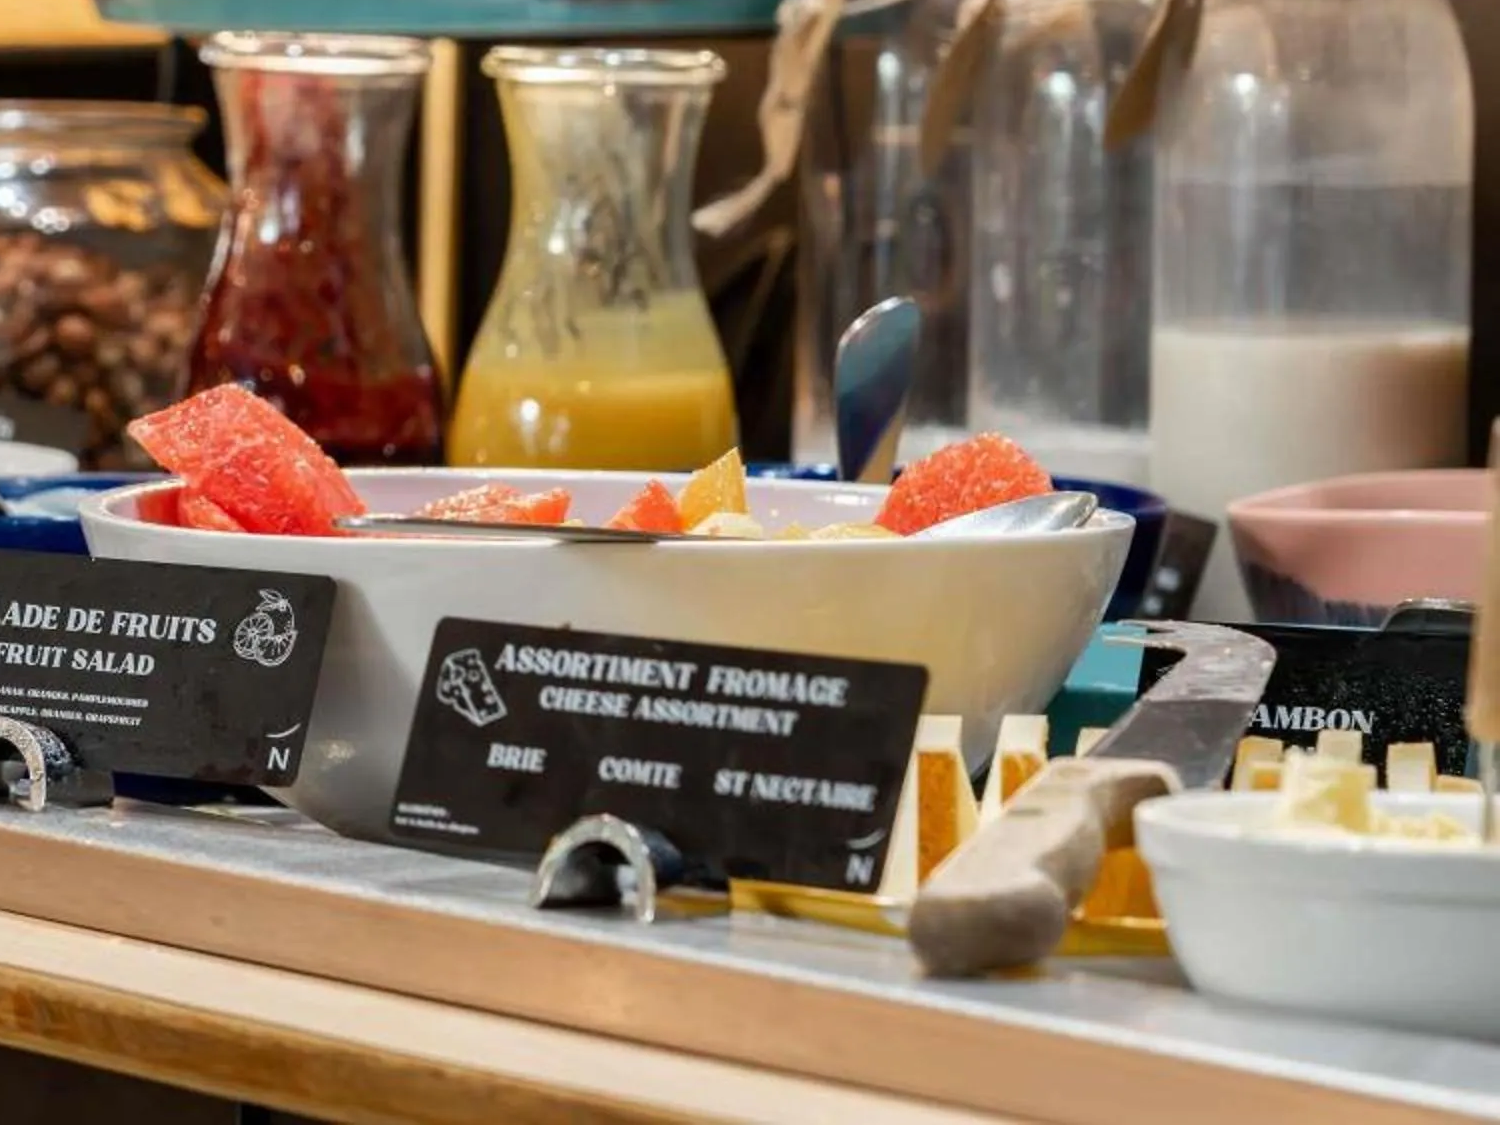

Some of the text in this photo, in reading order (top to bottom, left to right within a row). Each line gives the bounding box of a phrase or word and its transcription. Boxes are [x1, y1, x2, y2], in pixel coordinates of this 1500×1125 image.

[65, 606, 105, 634] DE
[110, 610, 217, 644] FRUITS
[71, 648, 155, 675] SALAD
[495, 644, 848, 706] ASSORTIMENT FROMAGE
[539, 686, 800, 737] CHEESE ASSORTMENT
[1250, 704, 1375, 734] AMBON
[267, 745, 291, 771] N
[487, 742, 877, 812] BRIE COMTE ST NECTAIRE
